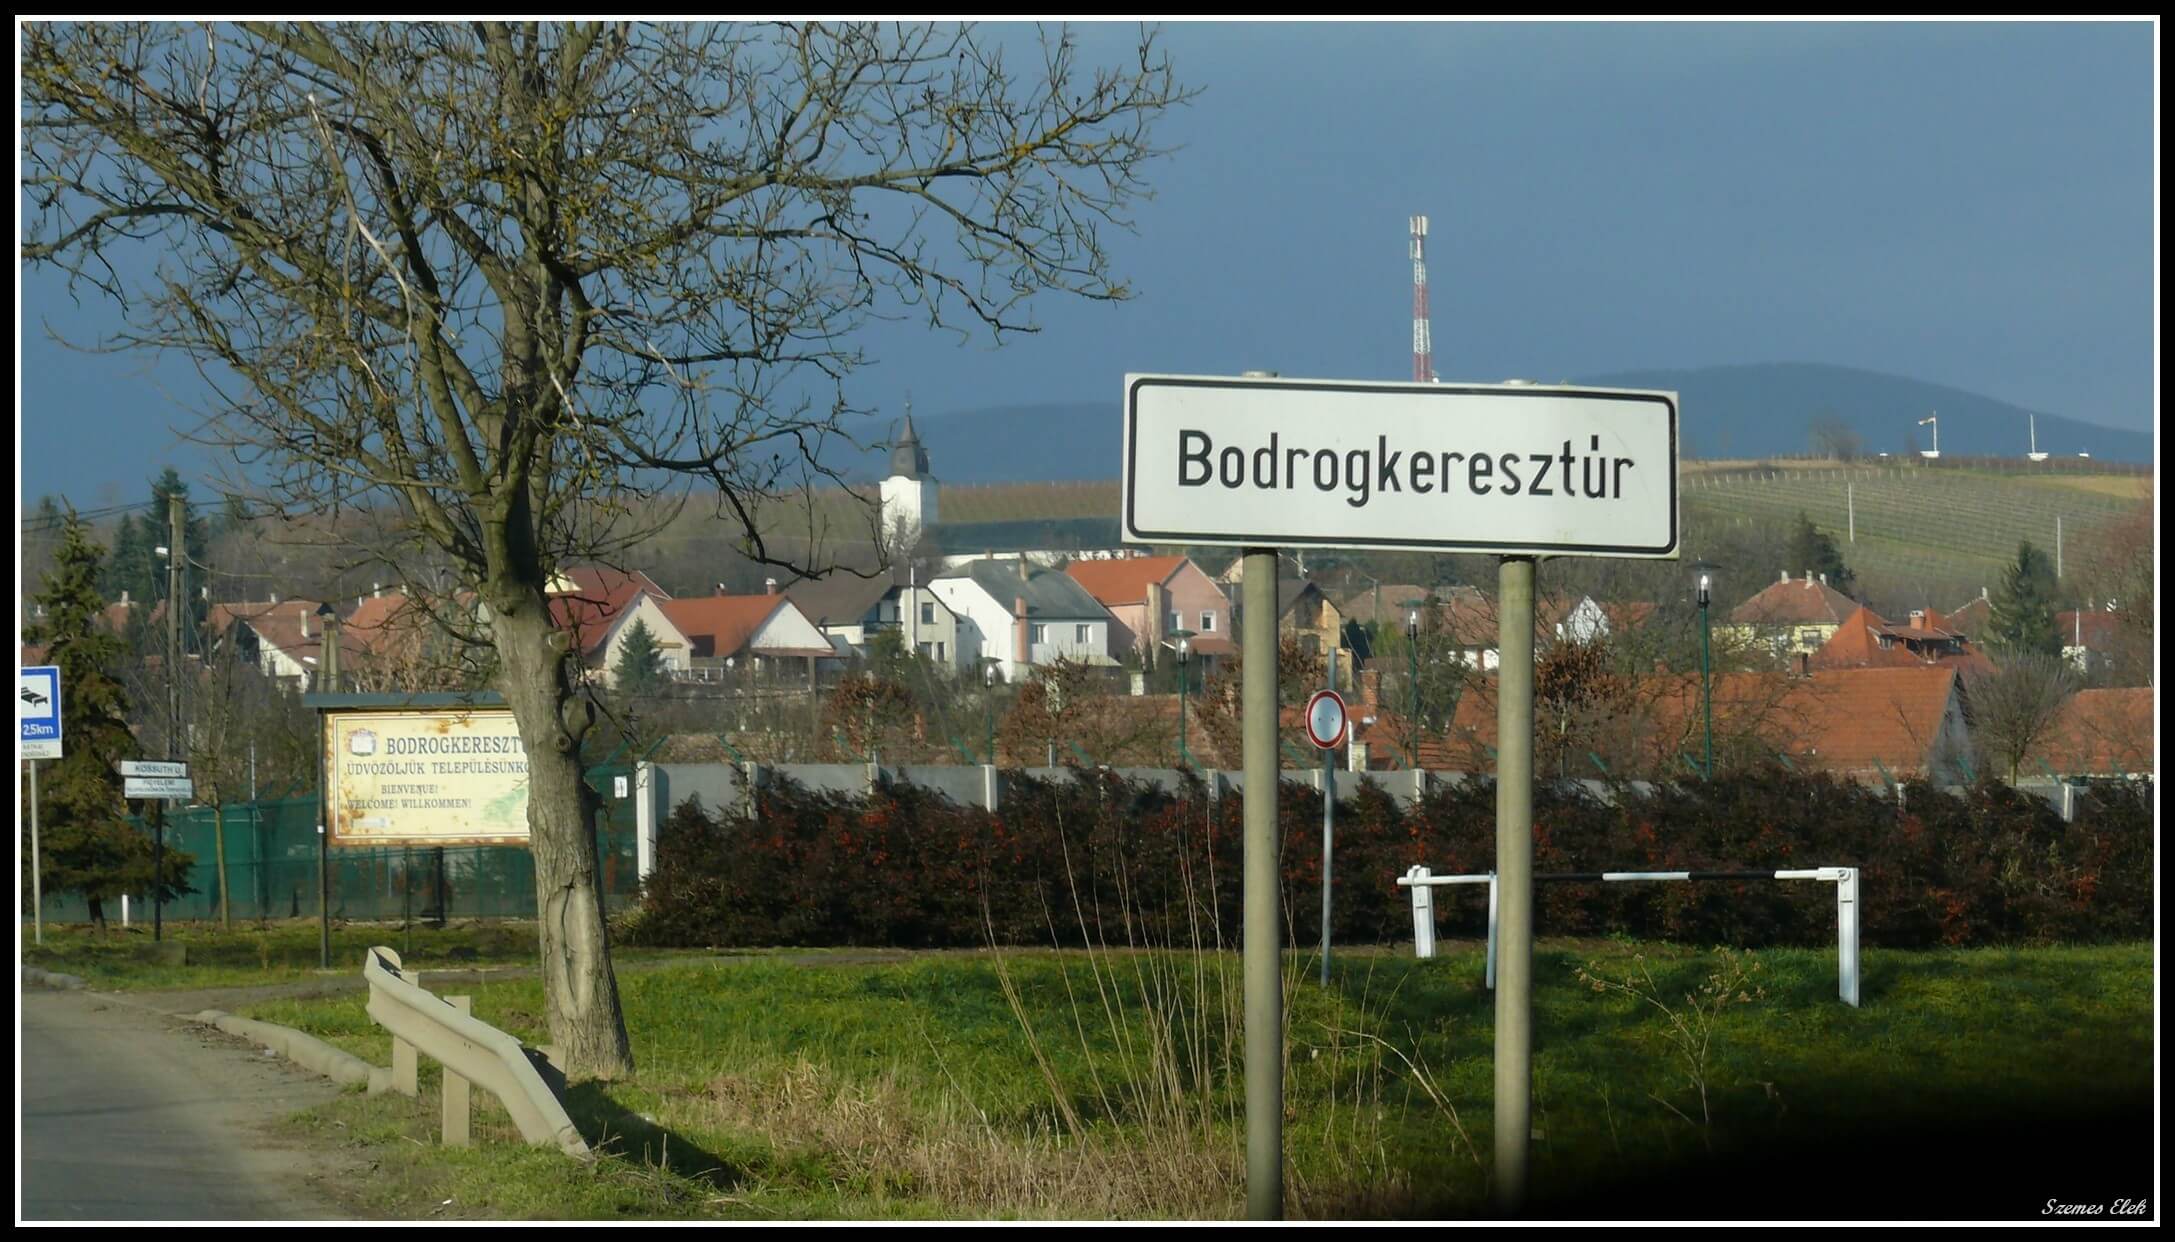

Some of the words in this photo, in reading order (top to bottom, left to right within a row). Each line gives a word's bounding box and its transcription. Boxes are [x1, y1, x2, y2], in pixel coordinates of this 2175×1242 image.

[1177, 428, 1635, 508] Bodrogkeresztúr
[381, 784, 439, 795] BIENVENUE!
[401, 798, 472, 809] WILLKOMMEN!
